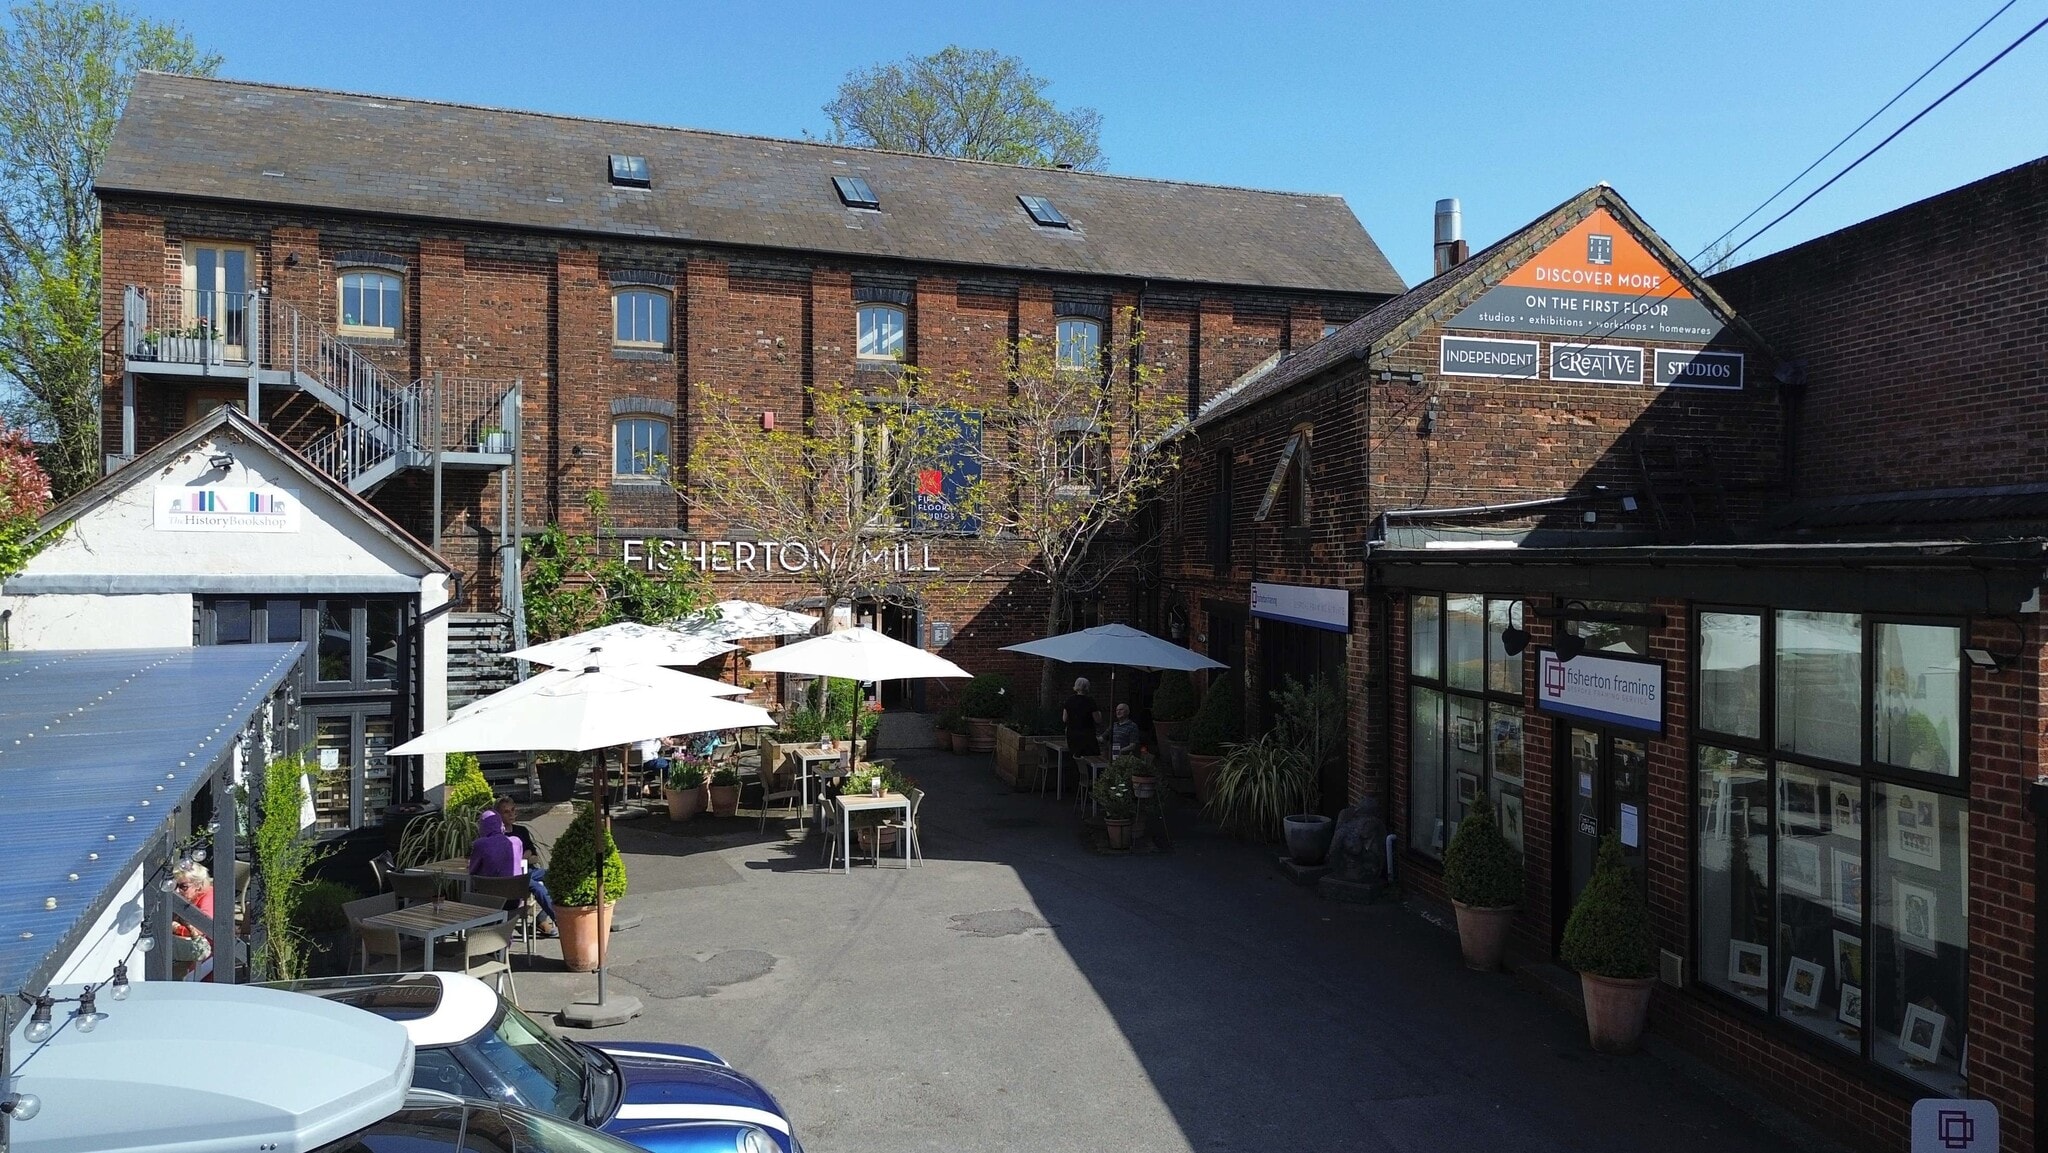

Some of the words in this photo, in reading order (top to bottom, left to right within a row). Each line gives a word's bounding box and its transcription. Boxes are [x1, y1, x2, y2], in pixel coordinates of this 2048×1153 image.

[1536, 267, 1612, 286] DISCOVER
[1619, 274, 1661, 289] MORE
[1526, 295, 1547, 308] ON
[1552, 297, 1577, 311] THE
[1583, 299, 1619, 313] FIRST
[1624, 302, 1669, 316] FLOOR
[1478, 312, 1515, 323] studios
[1529, 315, 1583, 327] exhibitions
[1659, 324, 1711, 335] homewares
[1446, 349, 1533, 366] INDEPENDENT
[1667, 361, 1730, 378] STUDIOS
[623, 540, 836, 572] FISHERTON
[861, 543, 941, 572] MILL
[1567, 668, 1611, 690] fisherton
[1614, 675, 1656, 700] framing
[1580, 823, 1596, 835] OPEN
